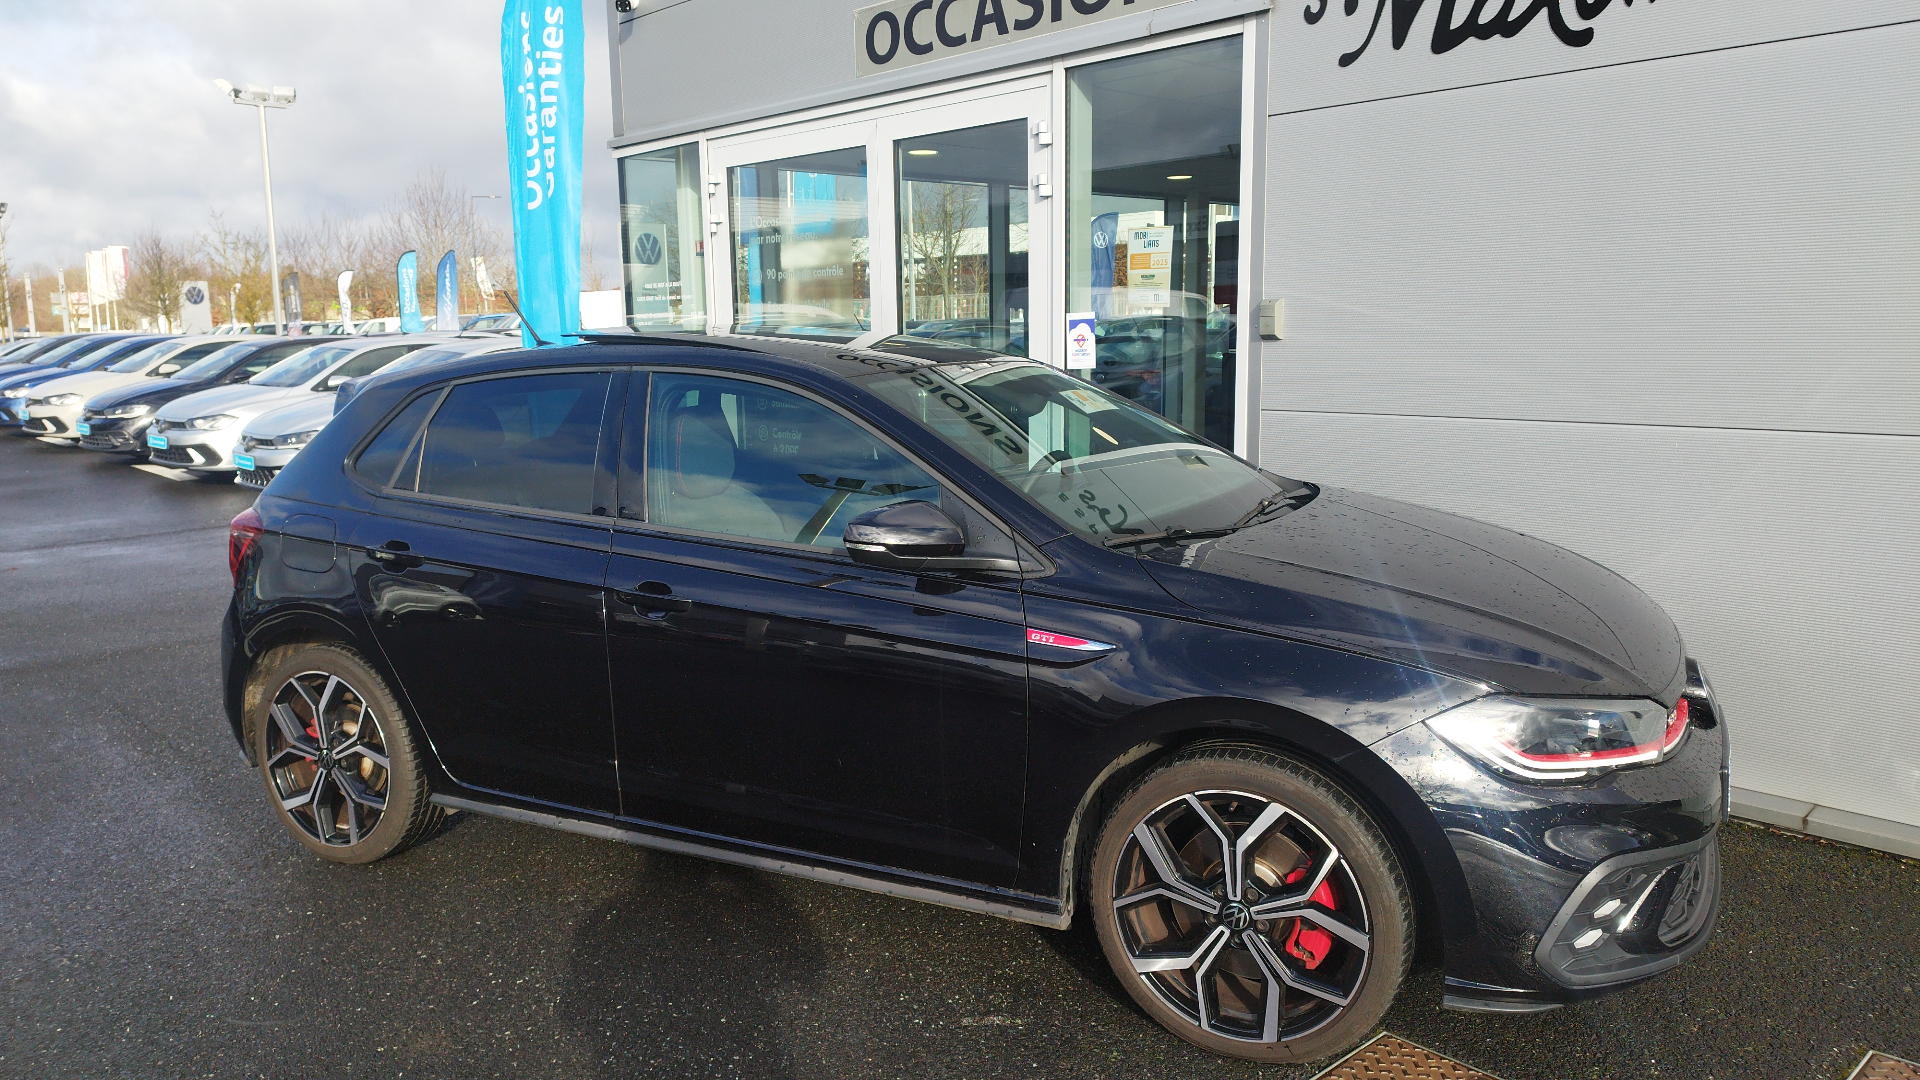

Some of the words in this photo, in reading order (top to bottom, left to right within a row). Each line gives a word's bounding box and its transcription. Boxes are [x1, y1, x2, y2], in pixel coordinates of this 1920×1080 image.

[766, 268, 776, 280] 90
[813, 264, 844, 278] contrôle
[1031, 633, 1055, 643] GTI
